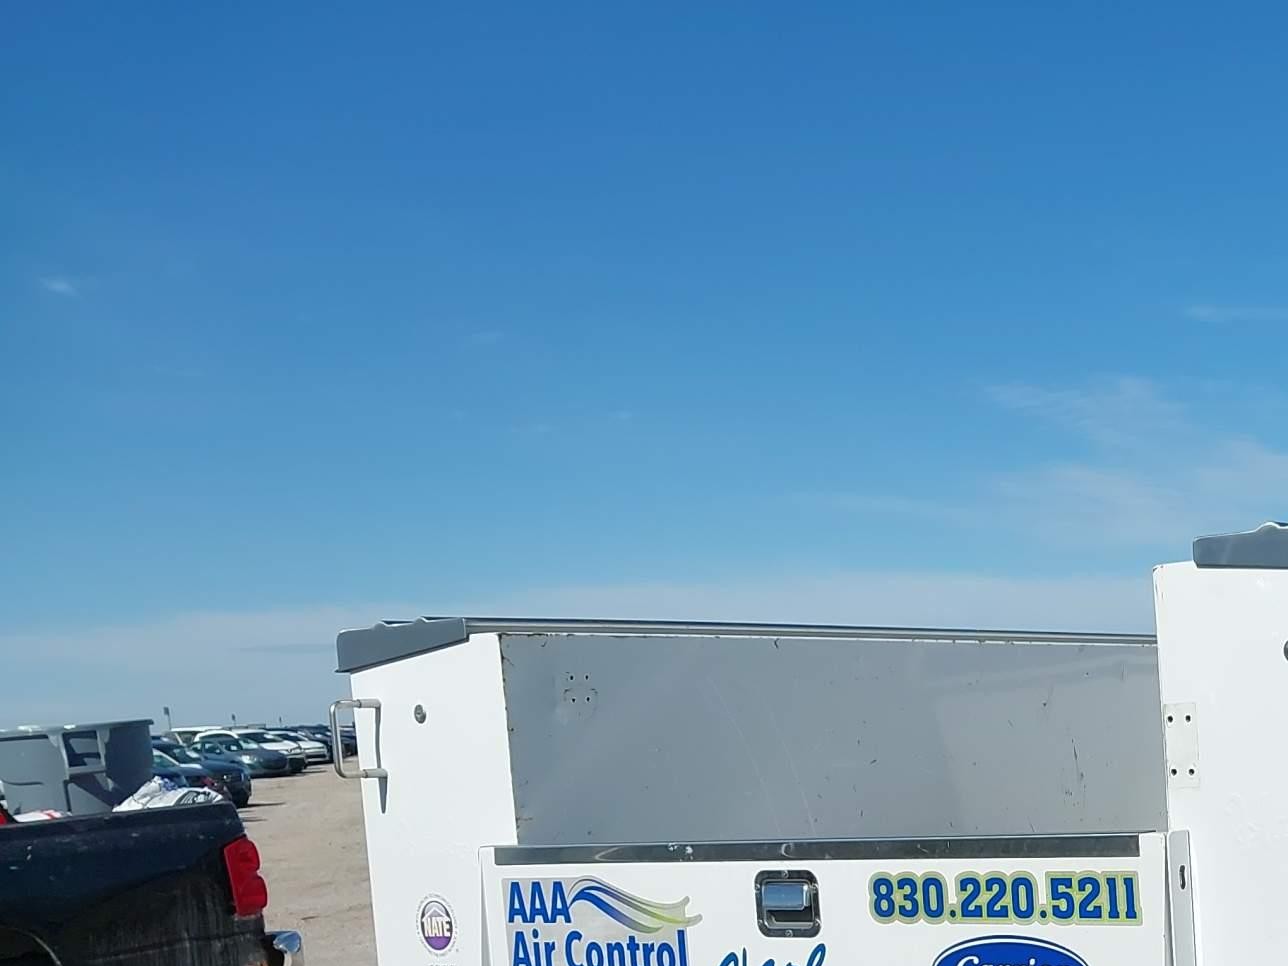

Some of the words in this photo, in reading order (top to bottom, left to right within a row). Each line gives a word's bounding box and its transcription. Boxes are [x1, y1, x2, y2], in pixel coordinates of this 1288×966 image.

[508, 881, 572, 924] AAA
[871, 876, 1138, 920] 830.220.5211
[422, 916, 451, 938] NATE
